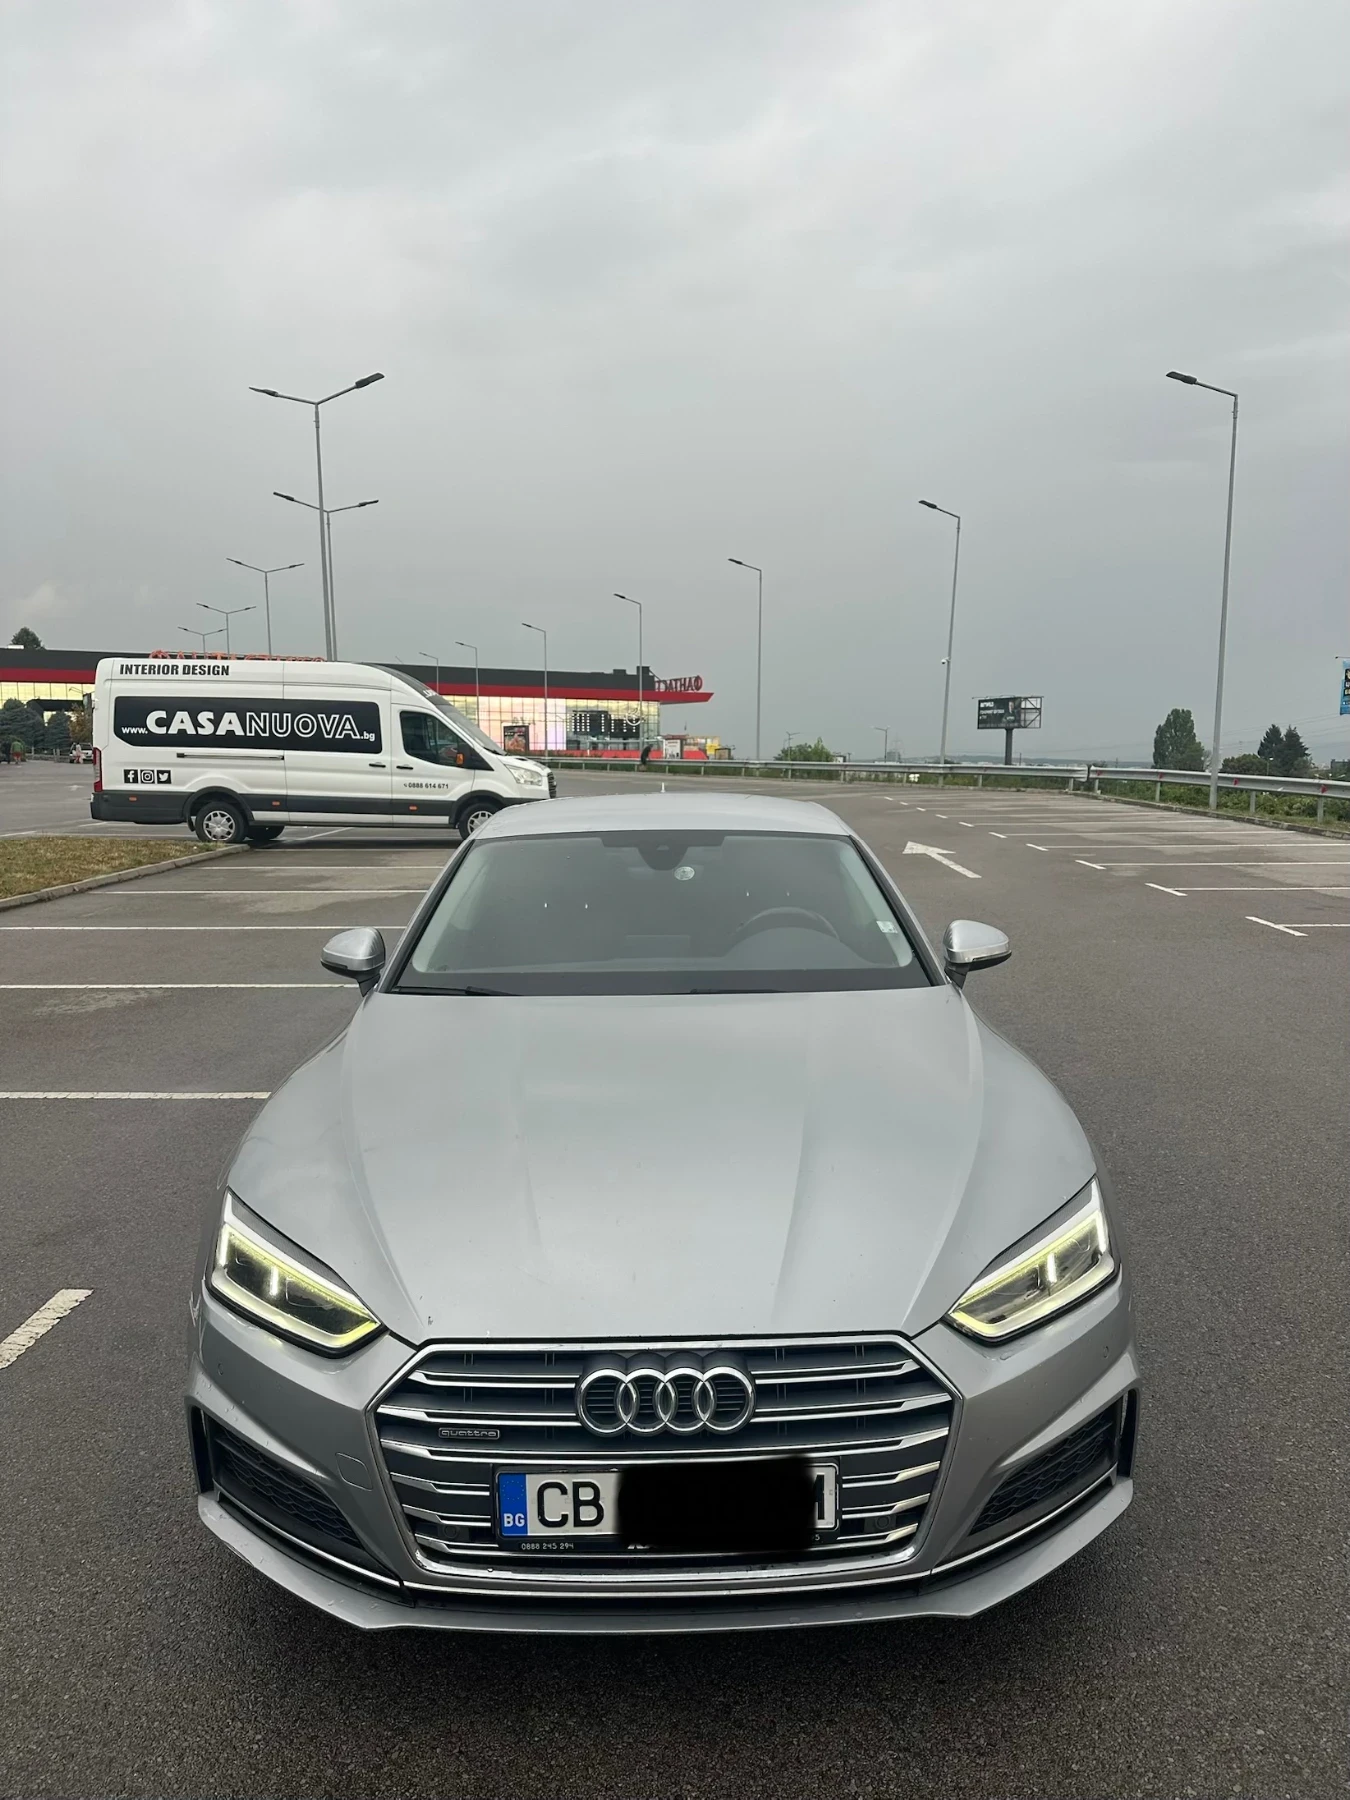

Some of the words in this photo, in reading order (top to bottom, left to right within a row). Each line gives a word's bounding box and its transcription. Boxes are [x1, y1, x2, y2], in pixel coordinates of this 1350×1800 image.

[119, 664, 179, 675] INTERIOR
[182, 664, 230, 676] DESIGN
[503, 1513, 525, 1527] BG
